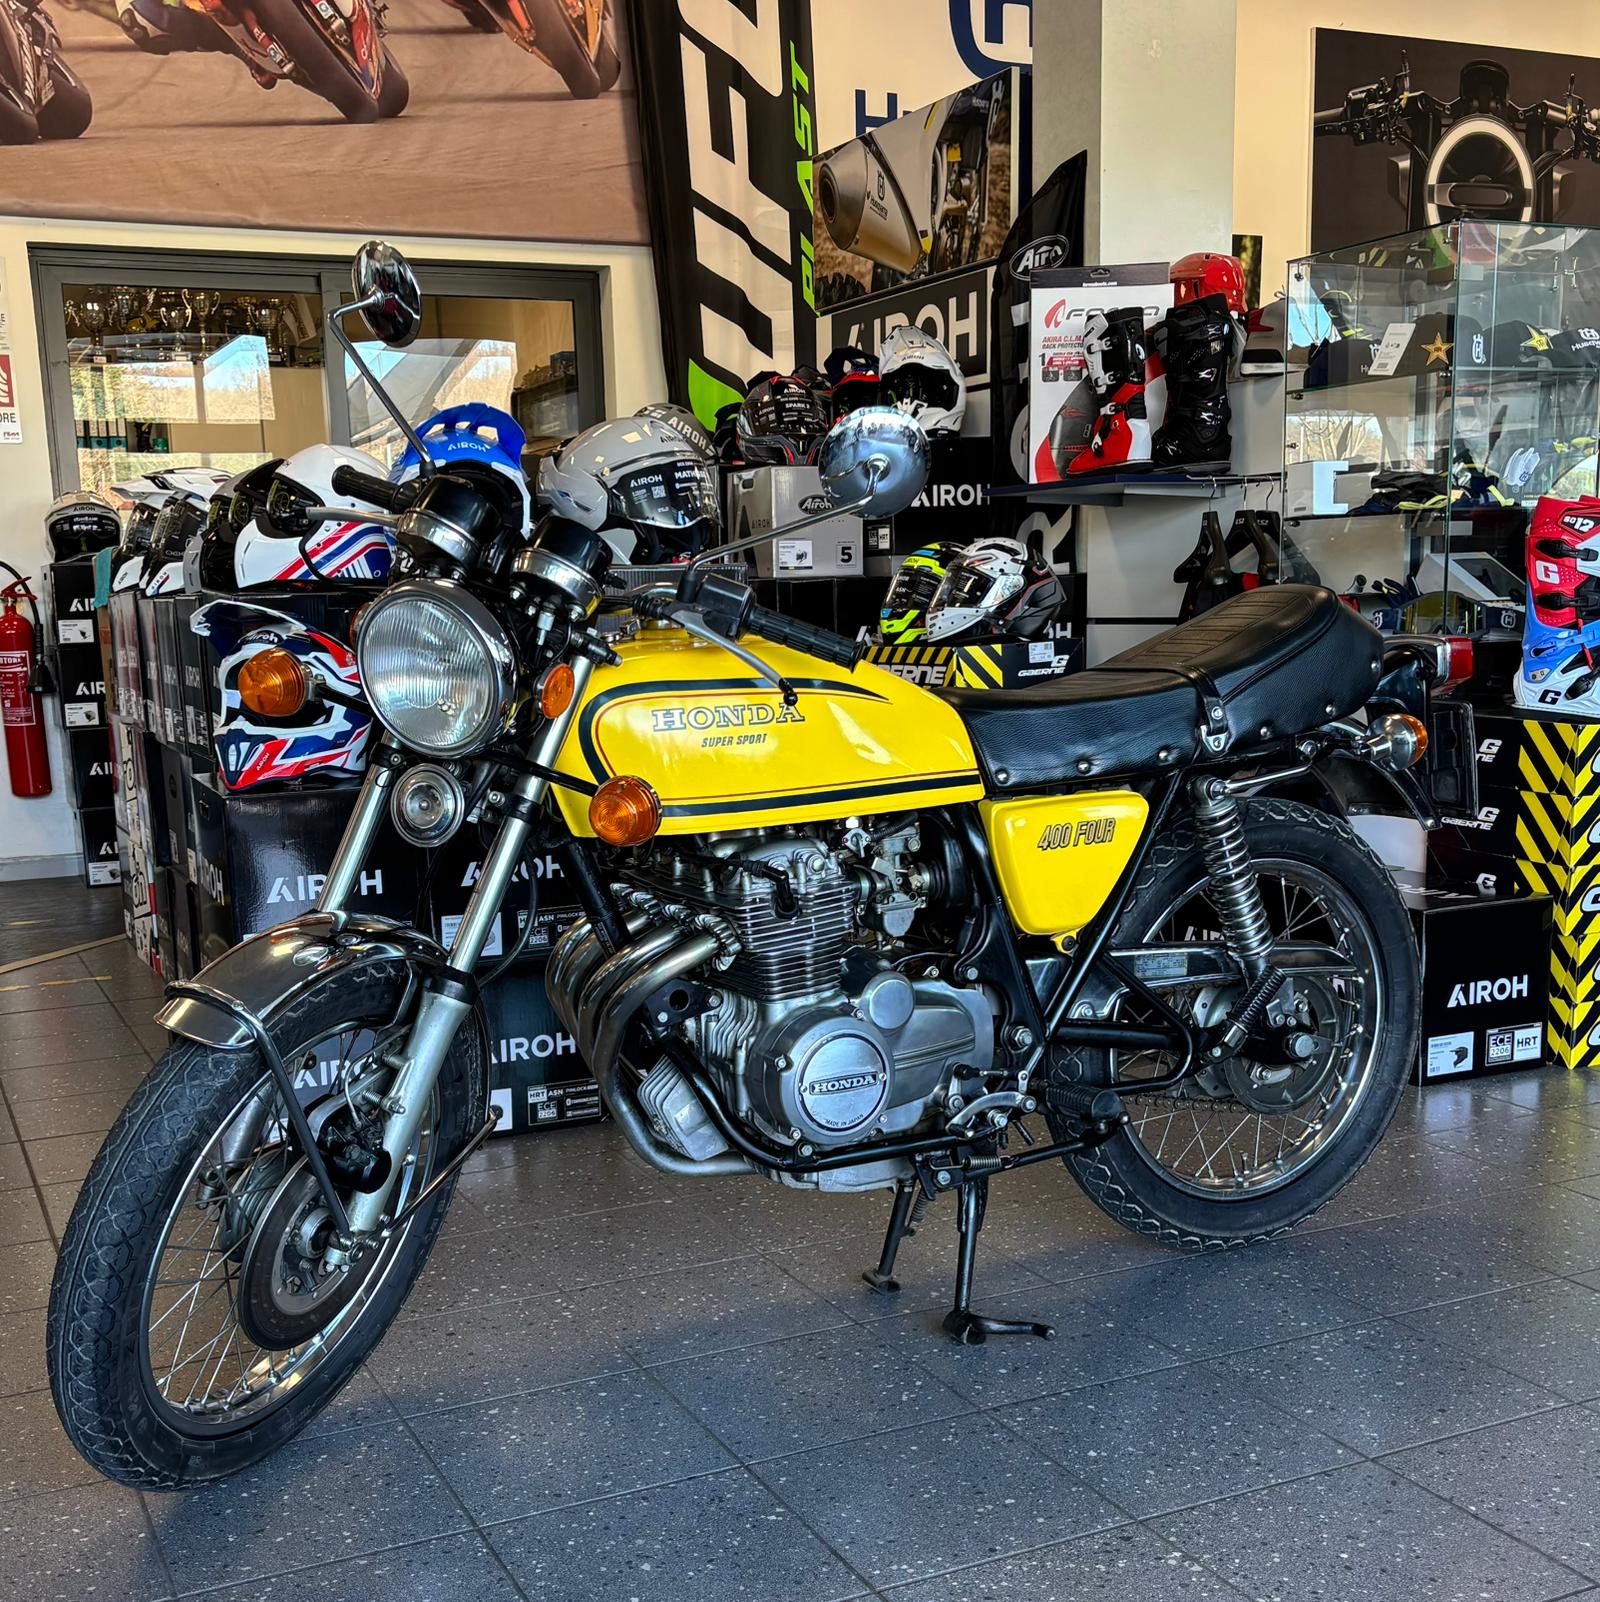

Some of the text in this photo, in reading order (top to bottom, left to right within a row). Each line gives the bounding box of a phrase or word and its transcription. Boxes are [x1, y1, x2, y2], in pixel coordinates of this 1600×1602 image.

[667, 416, 707, 450] AIROH
[447, 441, 487, 453] AIROH
[630, 474, 663, 488] AIROH
[801, 497, 833, 511] Airoh
[840, 546, 853, 563] 5
[652, 702, 805, 732] HONDA
[701, 733, 768, 748] SUPER SPORT
[1037, 817, 1116, 851] 400 FOUR
[460, 855, 566, 887] AOH
[266, 869, 383, 904] AIRH
[530, 928, 549, 937] CE
[1446, 974, 1528, 1008] AIROH
[490, 1032, 577, 1064] IROH
[1516, 1036, 1538, 1048] HRT
[1490, 1046, 1510, 1056] 2206
[813, 1075, 876, 1093] HONDA
[529, 1090, 546, 1099] HRT
[548, 1088, 564, 1097] ASN
[825, 1119, 839, 1127] MADE
[848, 1114, 864, 1125] JAPAN
